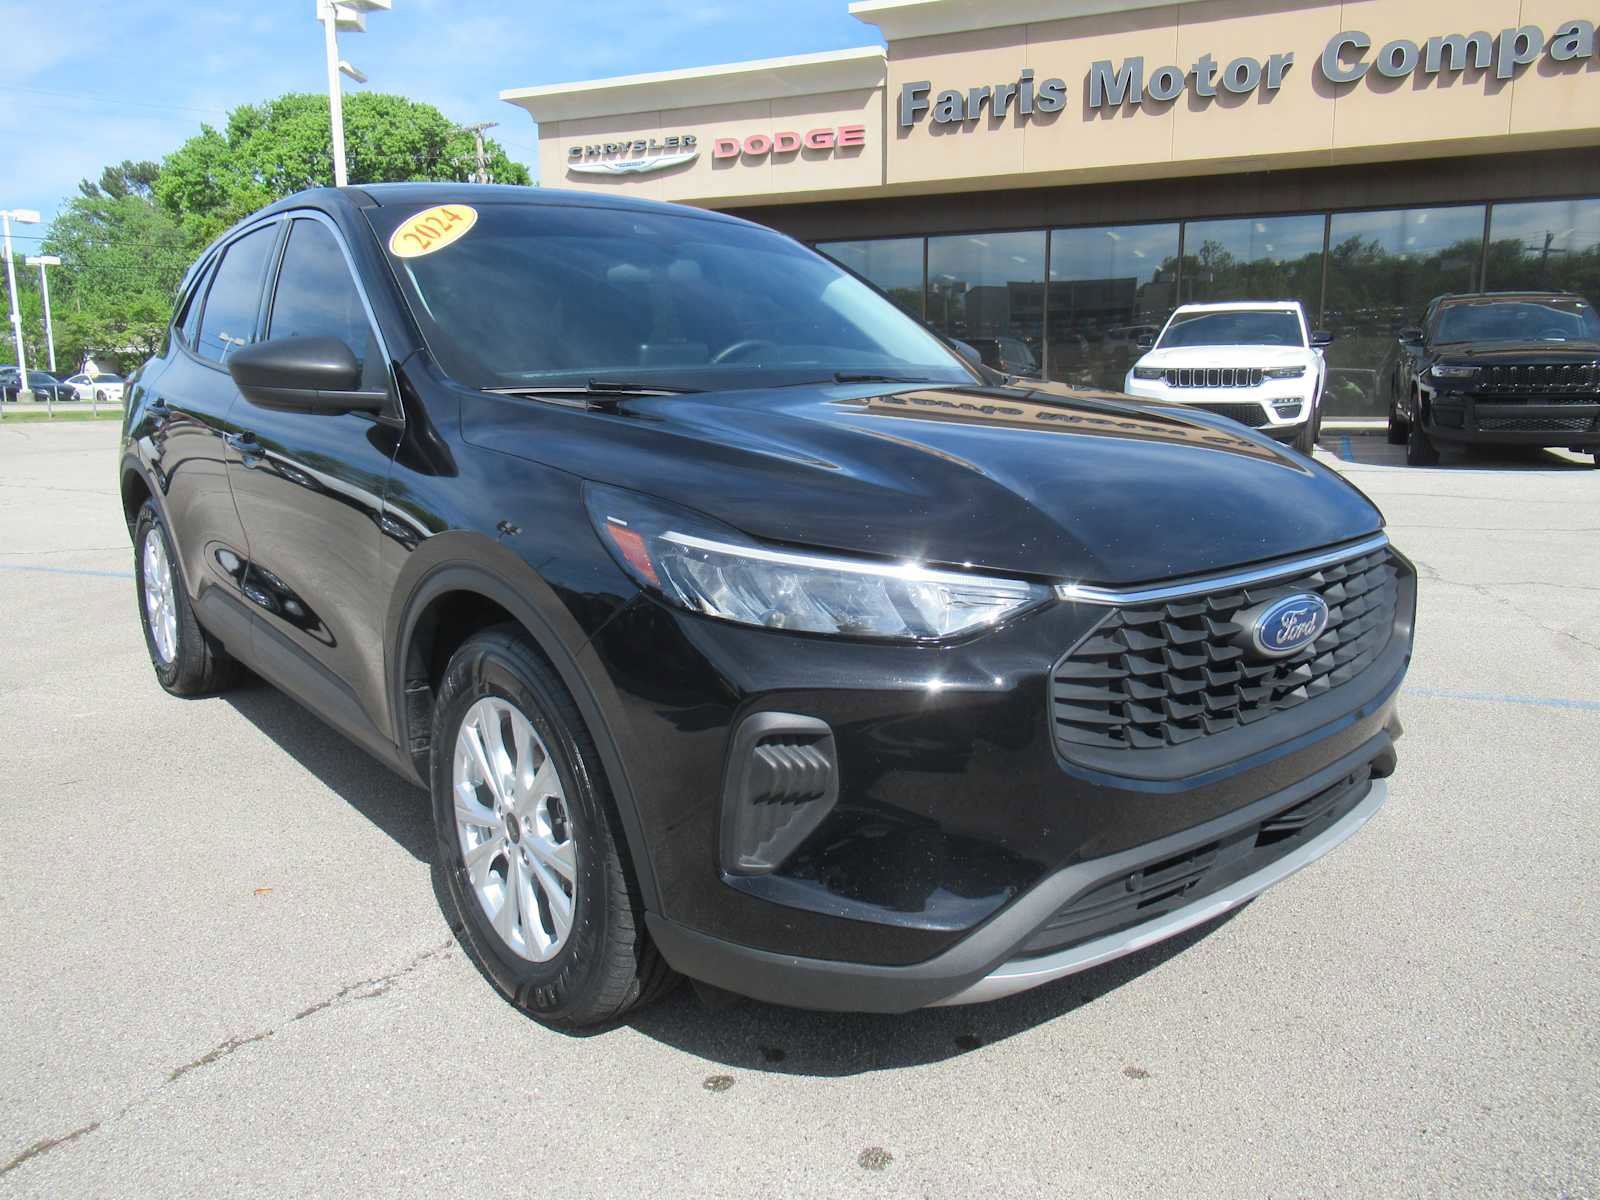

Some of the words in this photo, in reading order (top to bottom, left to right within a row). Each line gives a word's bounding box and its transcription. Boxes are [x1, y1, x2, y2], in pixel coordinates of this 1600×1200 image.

[901, 68, 1067, 127] Farris
[1088, 51, 1295, 108] Motor
[1322, 19, 1595, 83] Compa
[568, 134, 697, 158] CHRYSLER
[714, 124, 866, 158] DODGE
[403, 208, 464, 251] 2024
[1276, 607, 1317, 645] Ford
